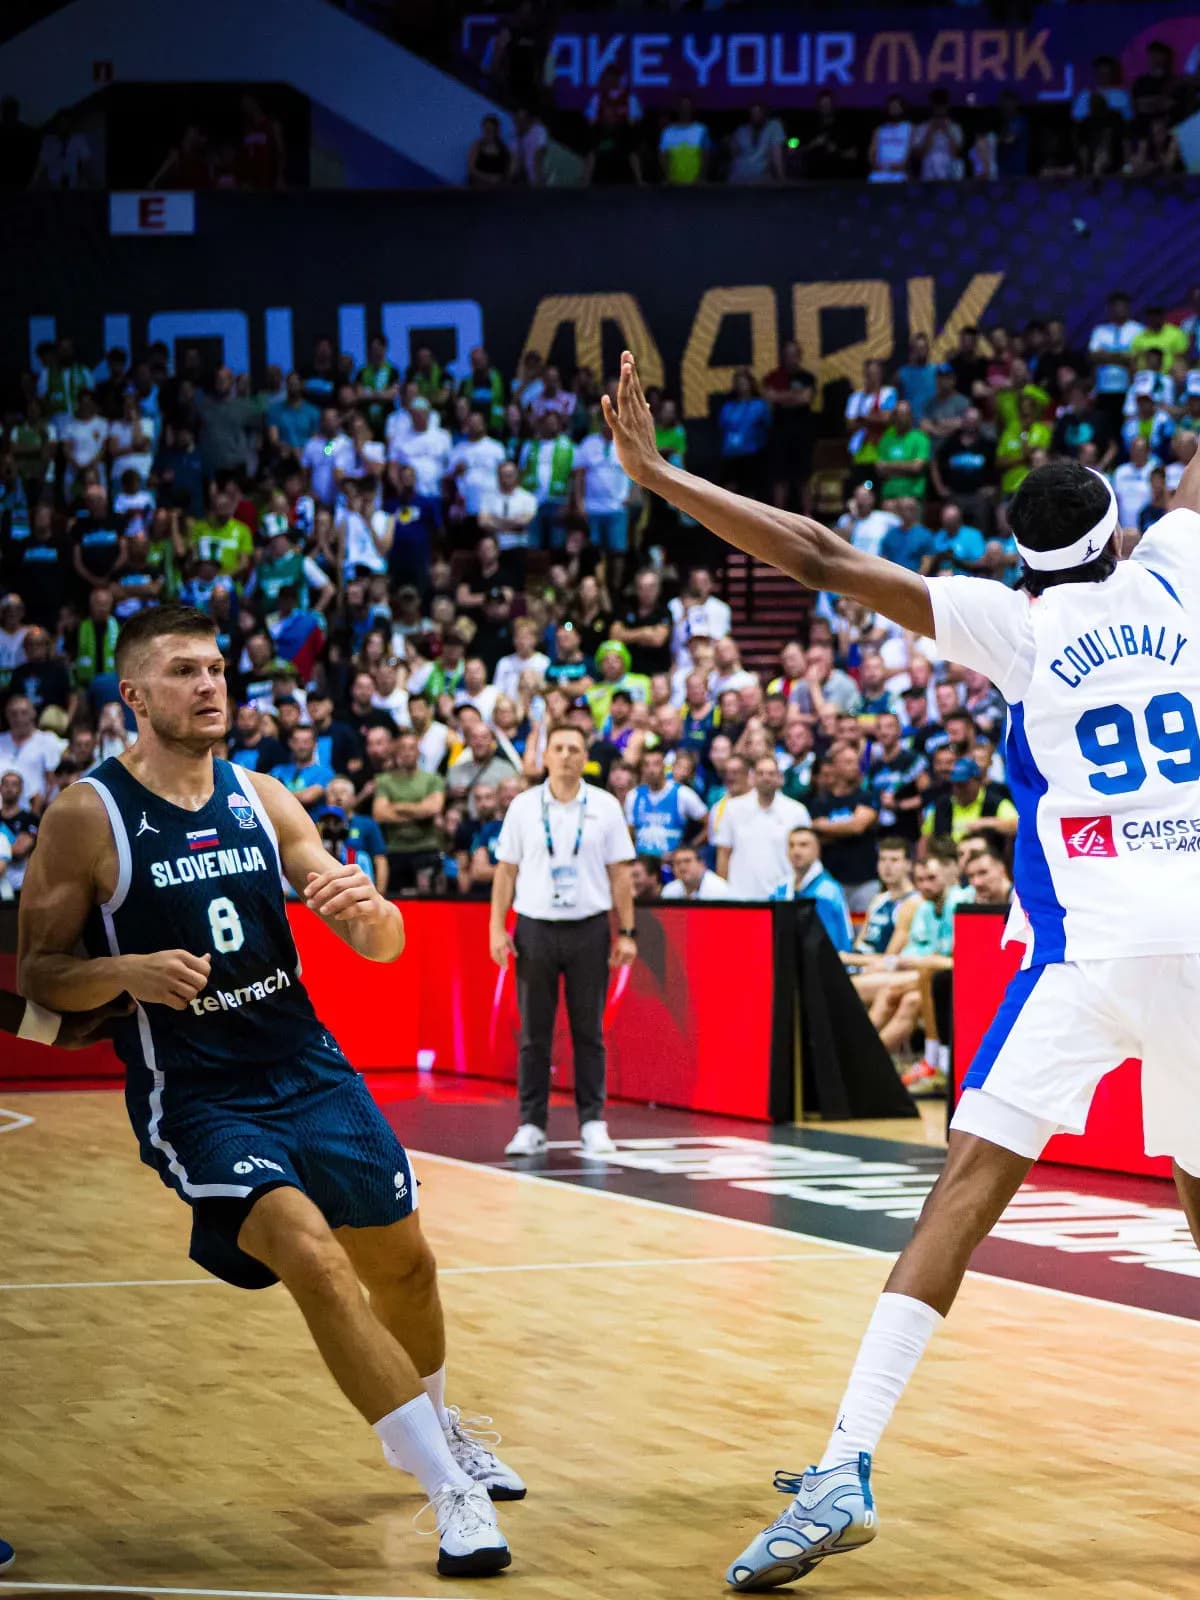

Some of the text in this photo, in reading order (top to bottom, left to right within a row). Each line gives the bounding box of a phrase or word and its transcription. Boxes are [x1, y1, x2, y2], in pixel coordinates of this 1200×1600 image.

[482, 29, 1053, 86] AKE YOUR MARK
[139, 197, 166, 229] E
[516, 272, 1005, 418] MARK
[1050, 624, 1188, 688] COULIBALY
[150, 846, 267, 888] SLOVENIJA
[207, 896, 245, 954] 8
[190, 967, 291, 1016] telemach
